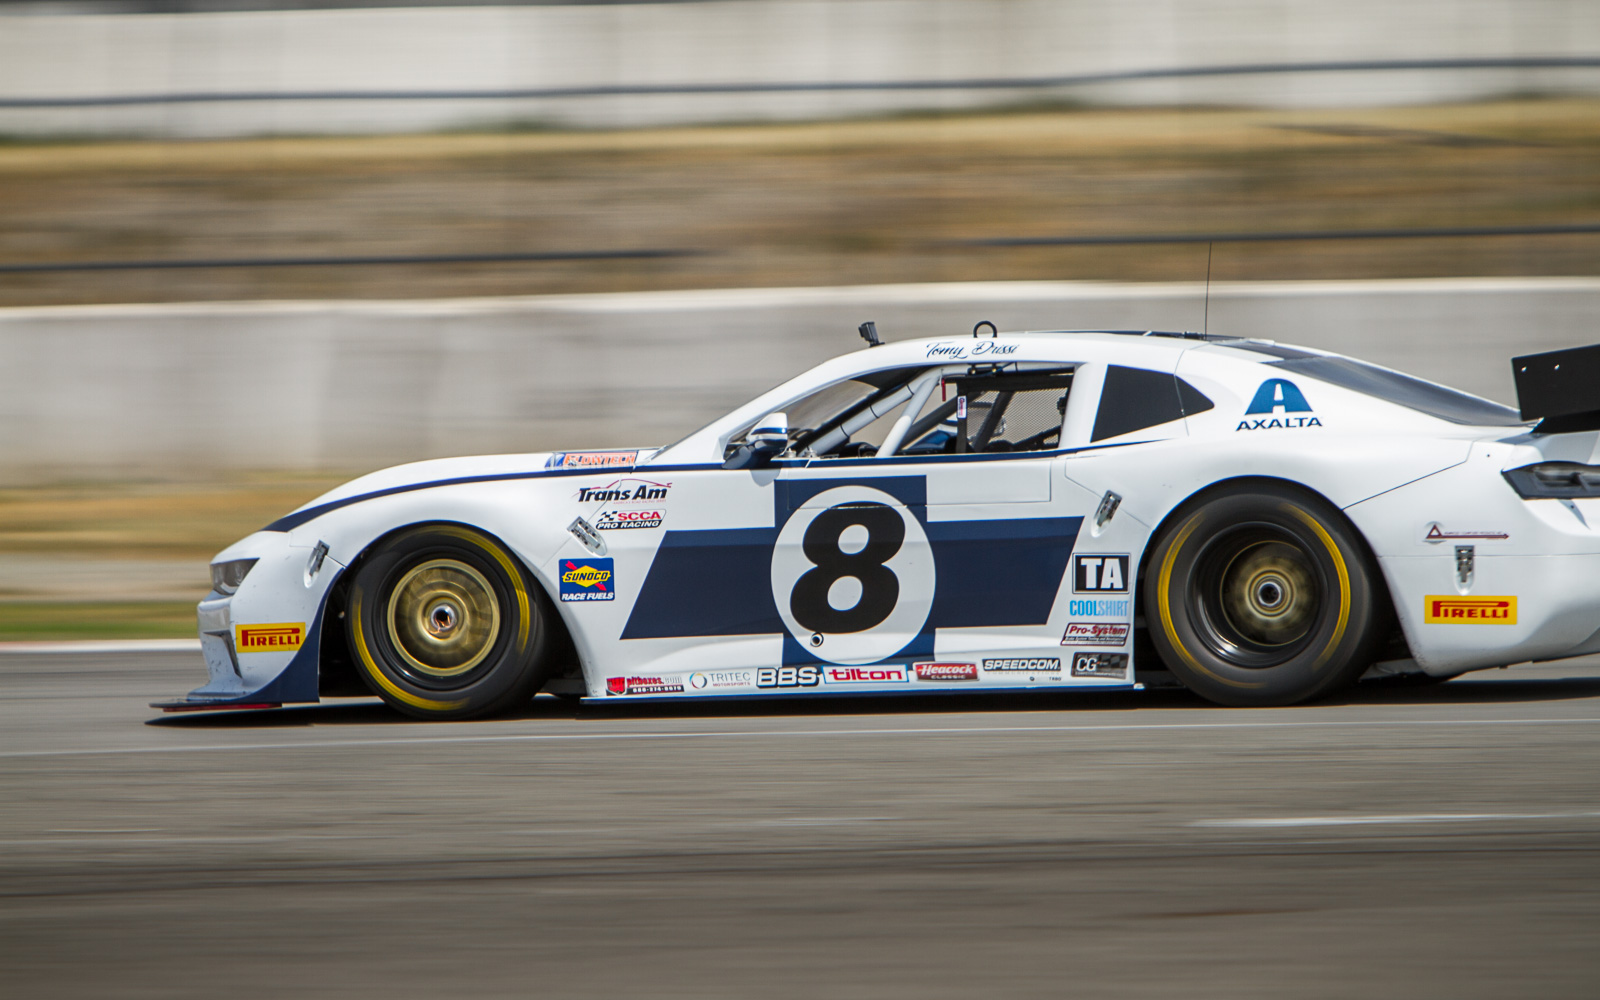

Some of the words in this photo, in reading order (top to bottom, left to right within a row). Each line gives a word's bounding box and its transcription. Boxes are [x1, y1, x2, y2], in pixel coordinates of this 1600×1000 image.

[926, 341, 968, 360] Tomy
[1235, 417, 1322, 432] AXALTA
[578, 487, 631, 502] Trans
[632, 485, 667, 500] Am
[617, 511, 661, 521] SCCA
[620, 520, 660, 528] RACING
[790, 501, 906, 635] 8
[1080, 558, 1124, 589] TA
[564, 572, 608, 582] SUNOCO
[561, 593, 587, 601] RACE
[587, 592, 614, 600] FUELS
[1069, 600, 1128, 617] COOLSHIRT
[1432, 600, 1509, 618] PIRELLI
[241, 628, 300, 646] PIRELLI
[1069, 626, 1126, 636] Pro-System
[918, 664, 975, 676] Heacock
[1076, 658, 1098, 672] CG
[709, 672, 751, 682] TRITEC
[757, 667, 817, 687] BBS
[829, 669, 903, 681] tilton
